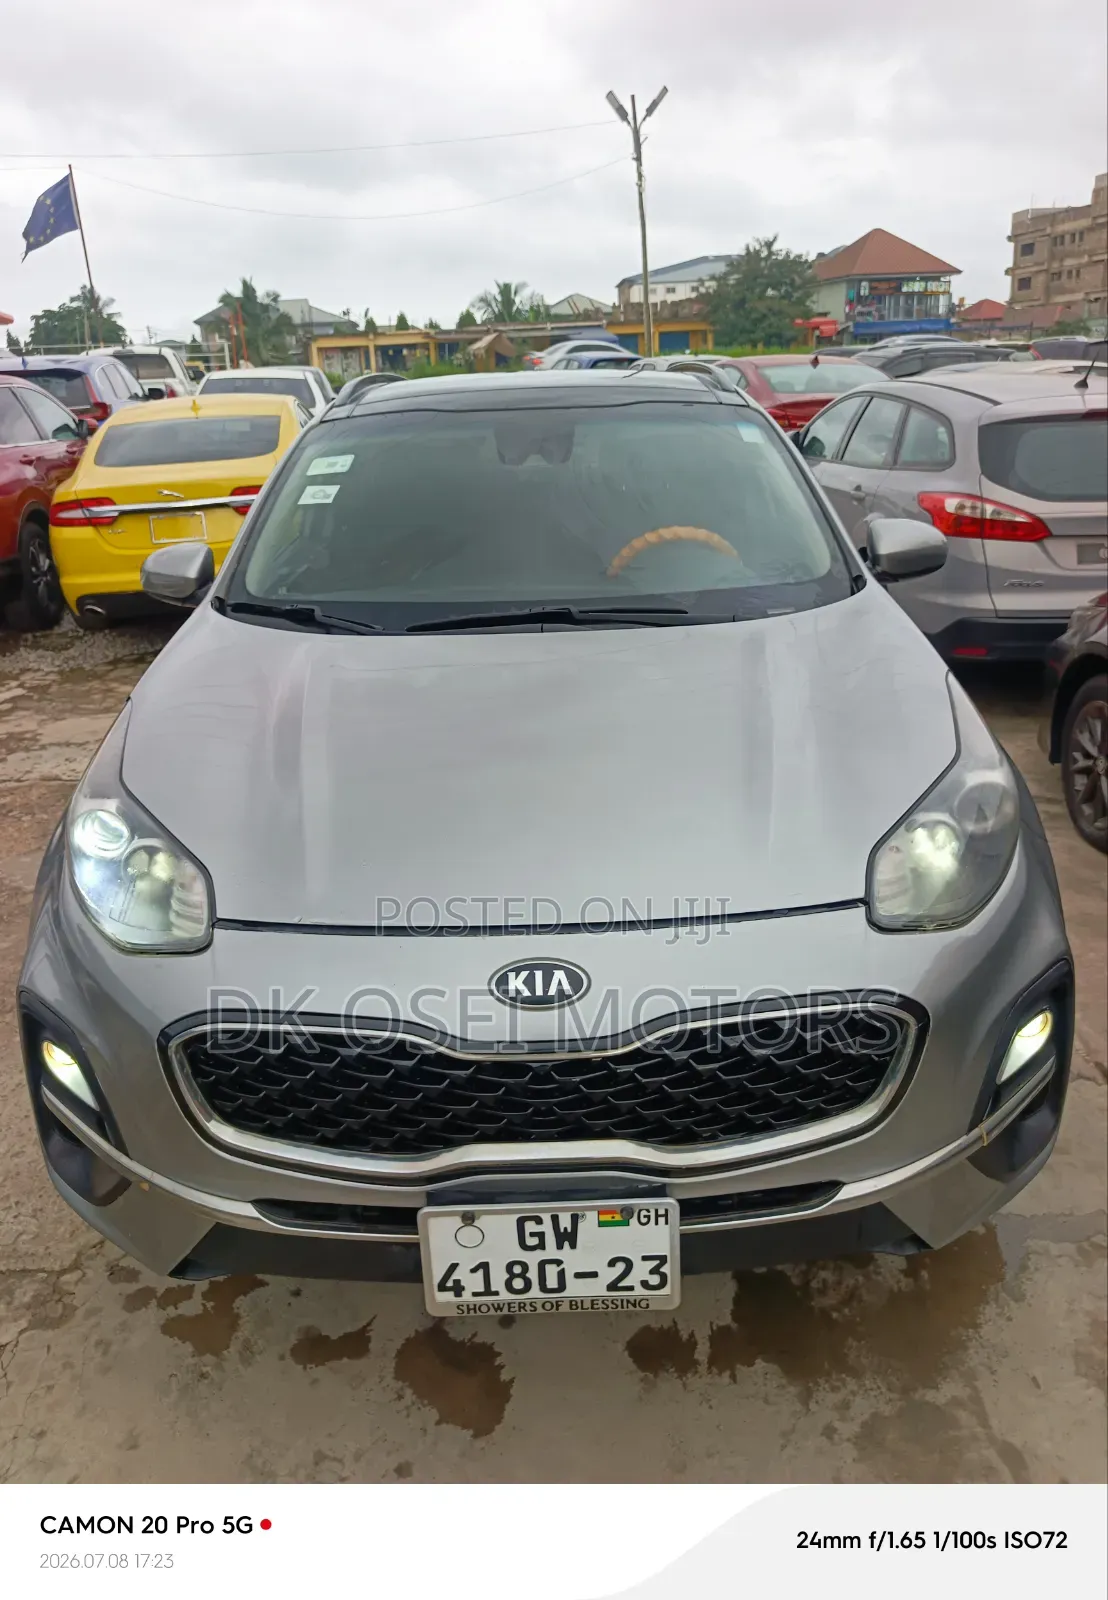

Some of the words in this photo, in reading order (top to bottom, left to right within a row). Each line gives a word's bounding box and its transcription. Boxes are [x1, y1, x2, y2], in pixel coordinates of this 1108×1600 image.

[507, 969, 573, 998] KIA
[637, 1208, 669, 1226] GH
[516, 1212, 579, 1252] GW
[437, 1254, 669, 1298] 4180-23
[456, 1300, 537, 1315] SHOWERS
[542, 1300, 563, 1311] OF
[568, 1298, 650, 1311] BLESSING
